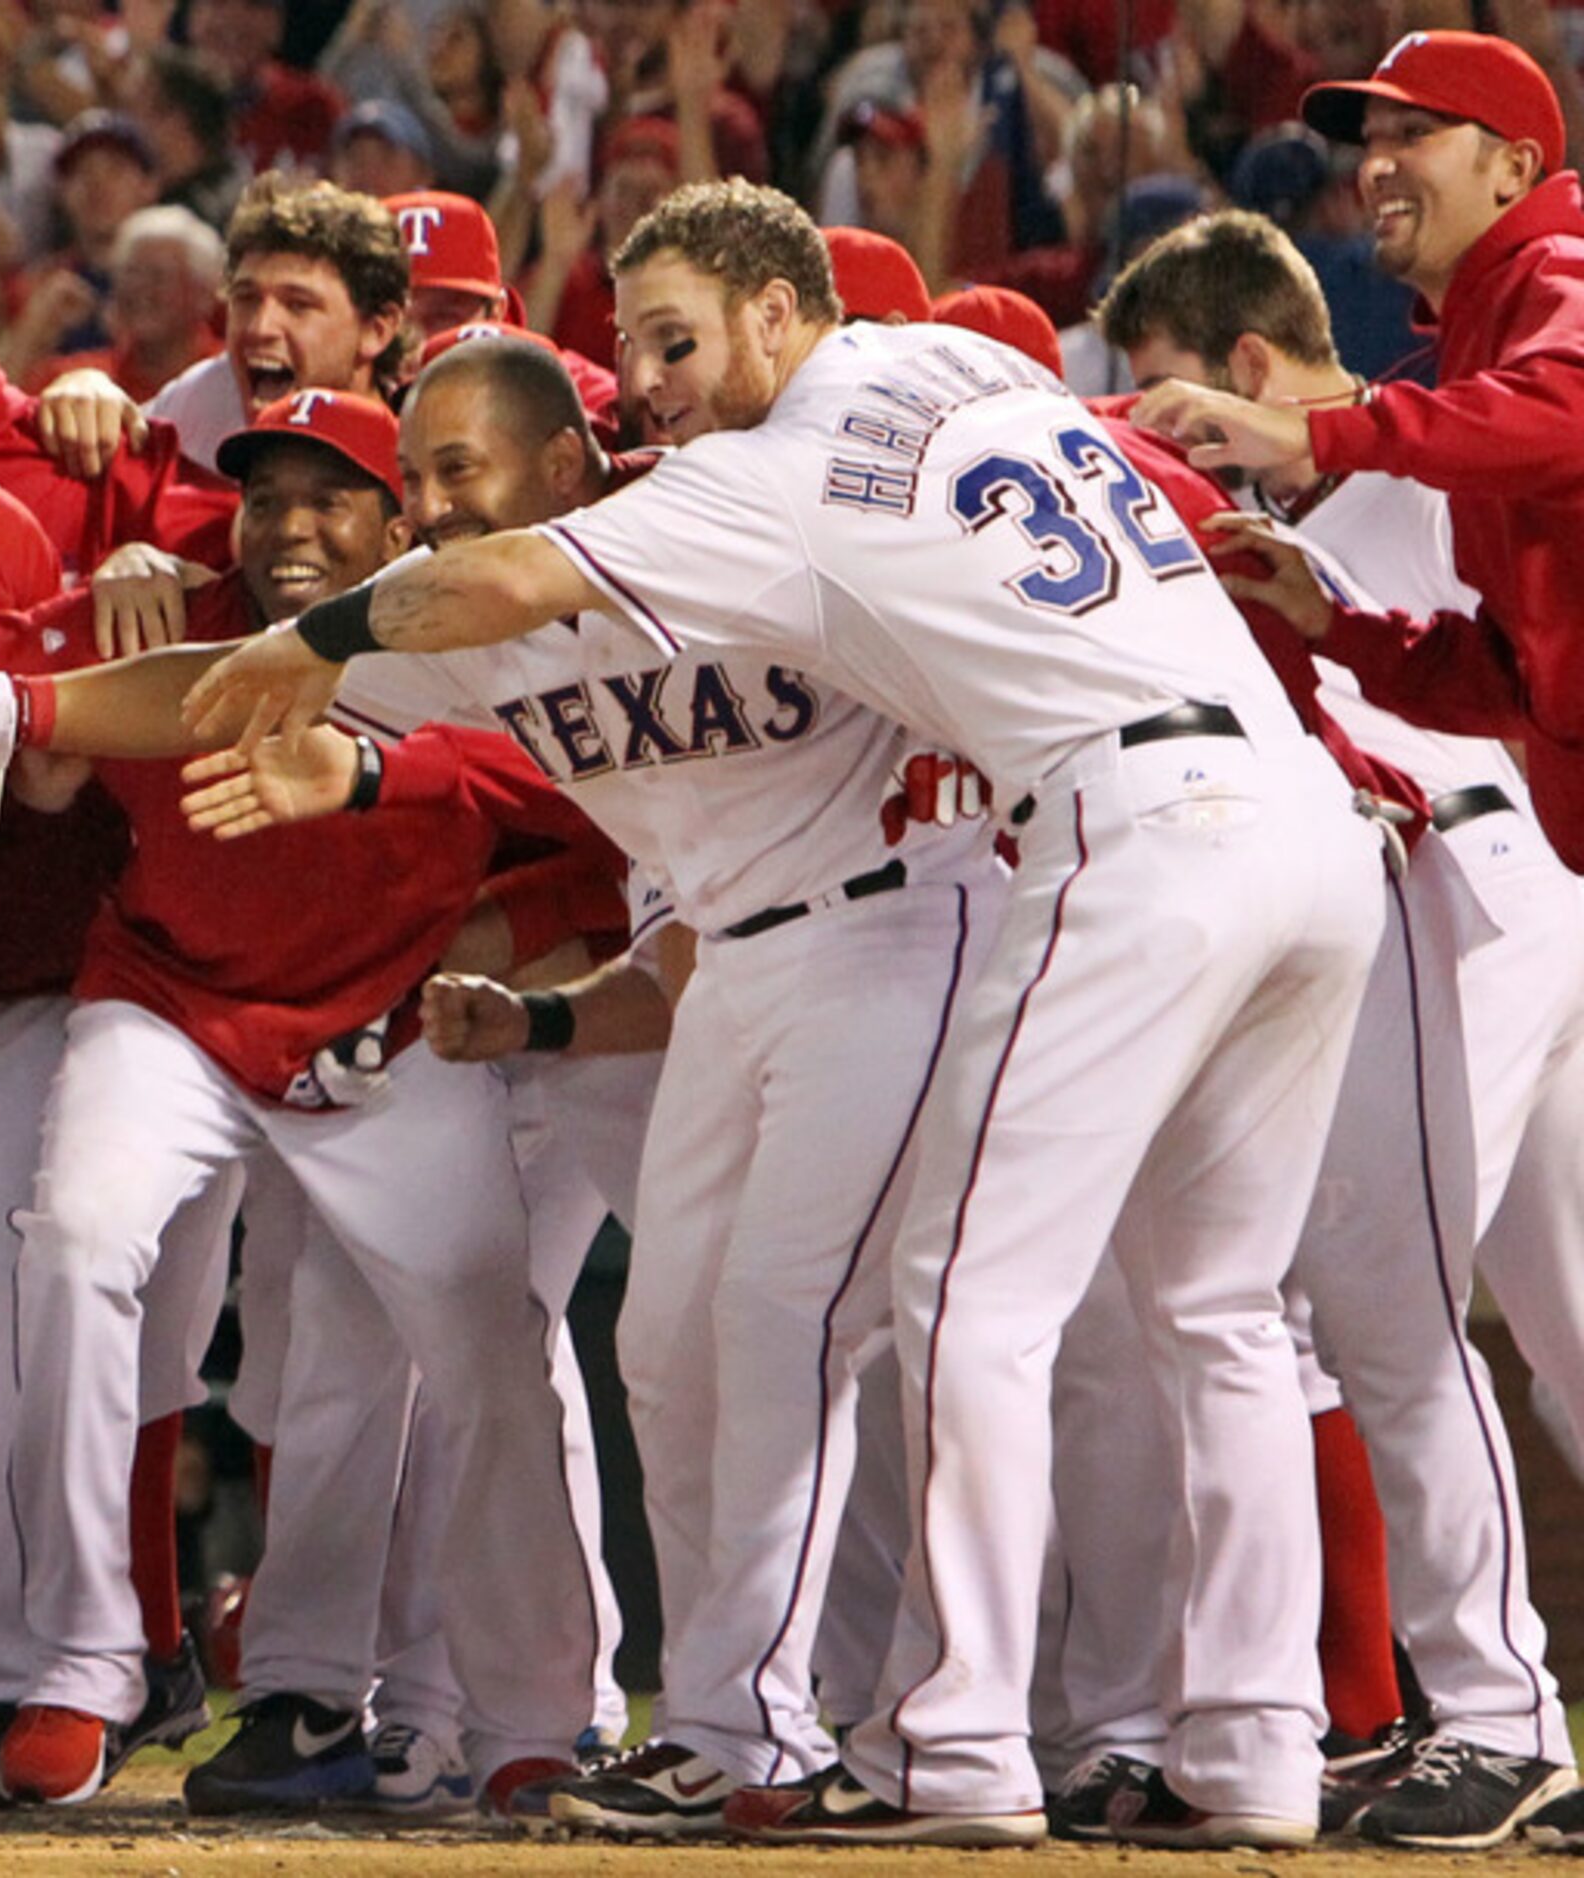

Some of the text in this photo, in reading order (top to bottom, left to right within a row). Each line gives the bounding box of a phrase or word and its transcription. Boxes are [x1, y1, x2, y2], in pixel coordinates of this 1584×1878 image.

[398, 206, 444, 256] T
[288, 387, 337, 425] T
[946, 424, 1208, 618] 32
[492, 662, 821, 784] TEXAS
